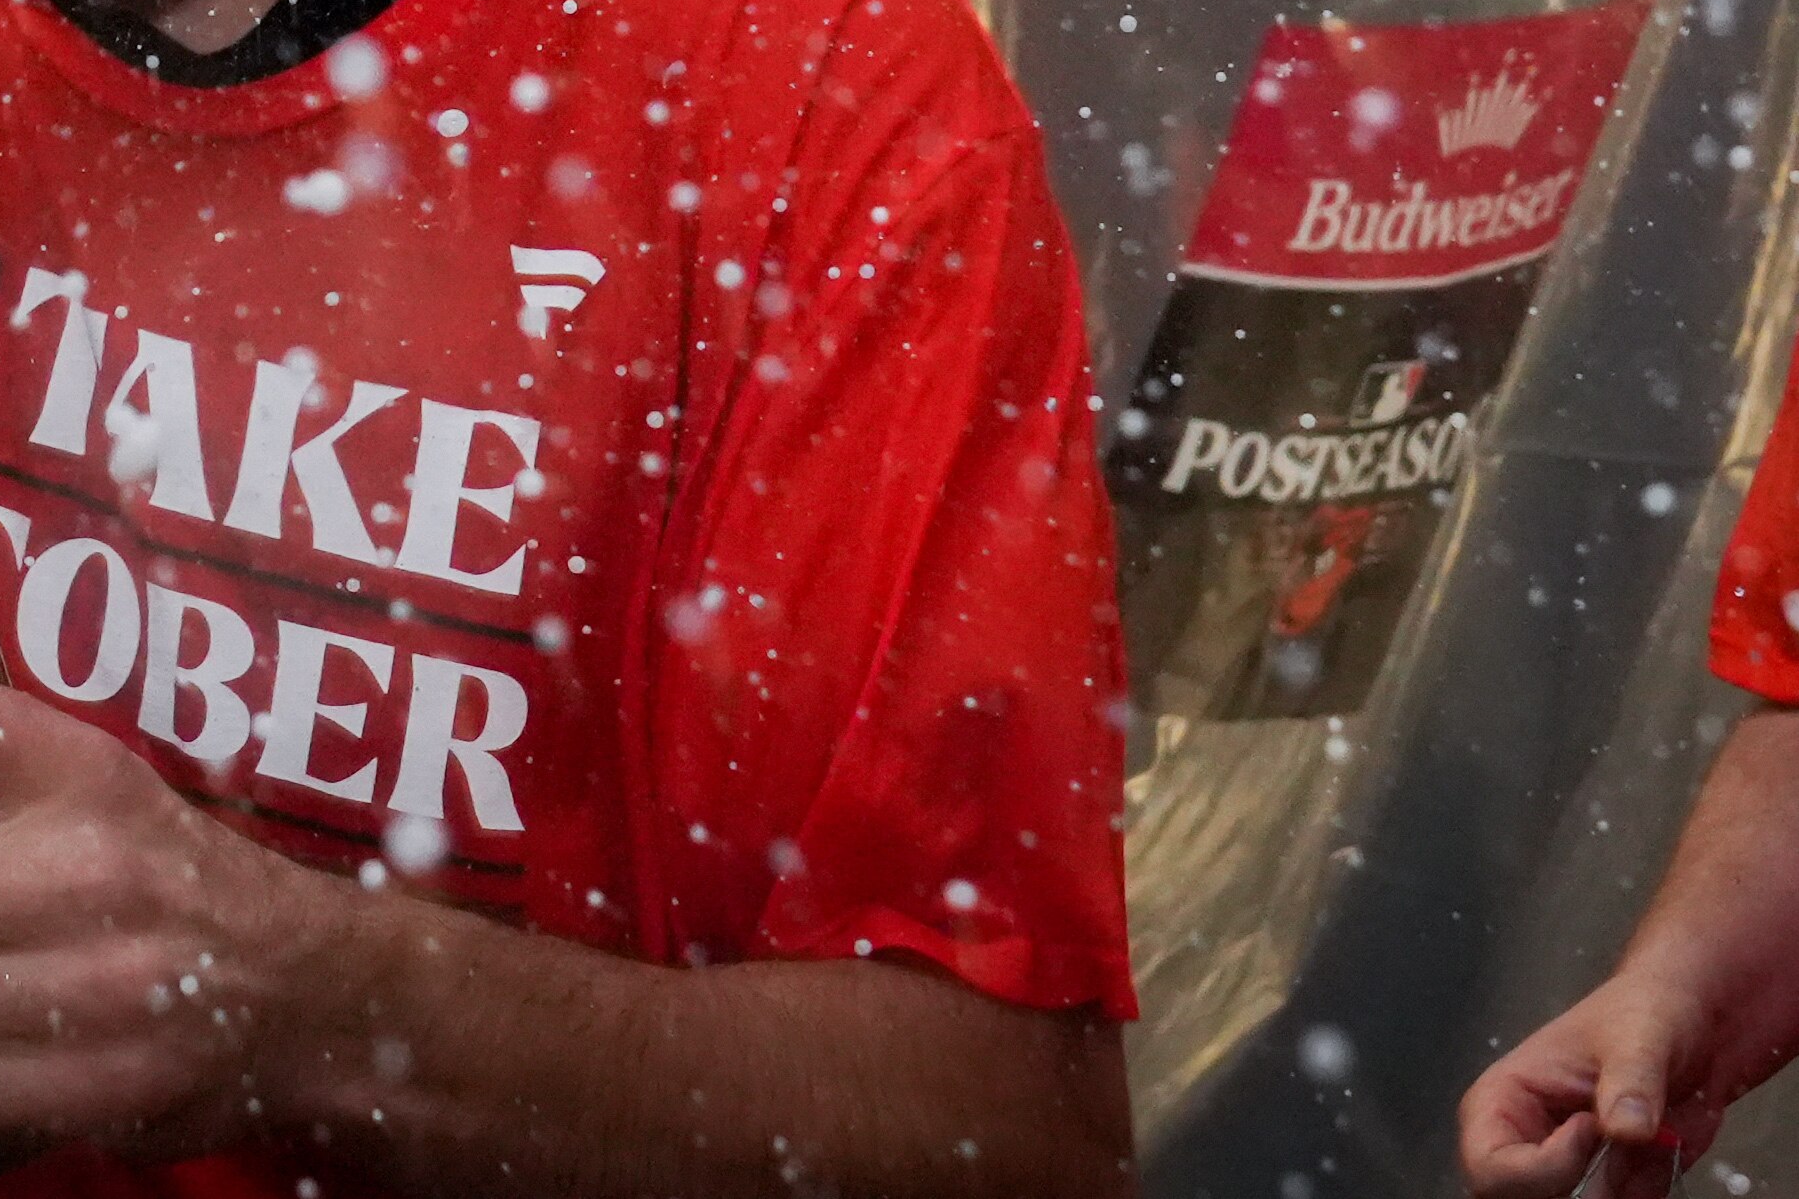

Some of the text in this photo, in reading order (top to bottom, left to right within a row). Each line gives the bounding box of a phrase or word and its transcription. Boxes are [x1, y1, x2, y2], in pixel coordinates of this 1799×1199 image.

[1288, 170, 1573, 252] Budweiser
[13, 266, 542, 597] TAKE
[1161, 417, 1464, 503] POSTSEASO
